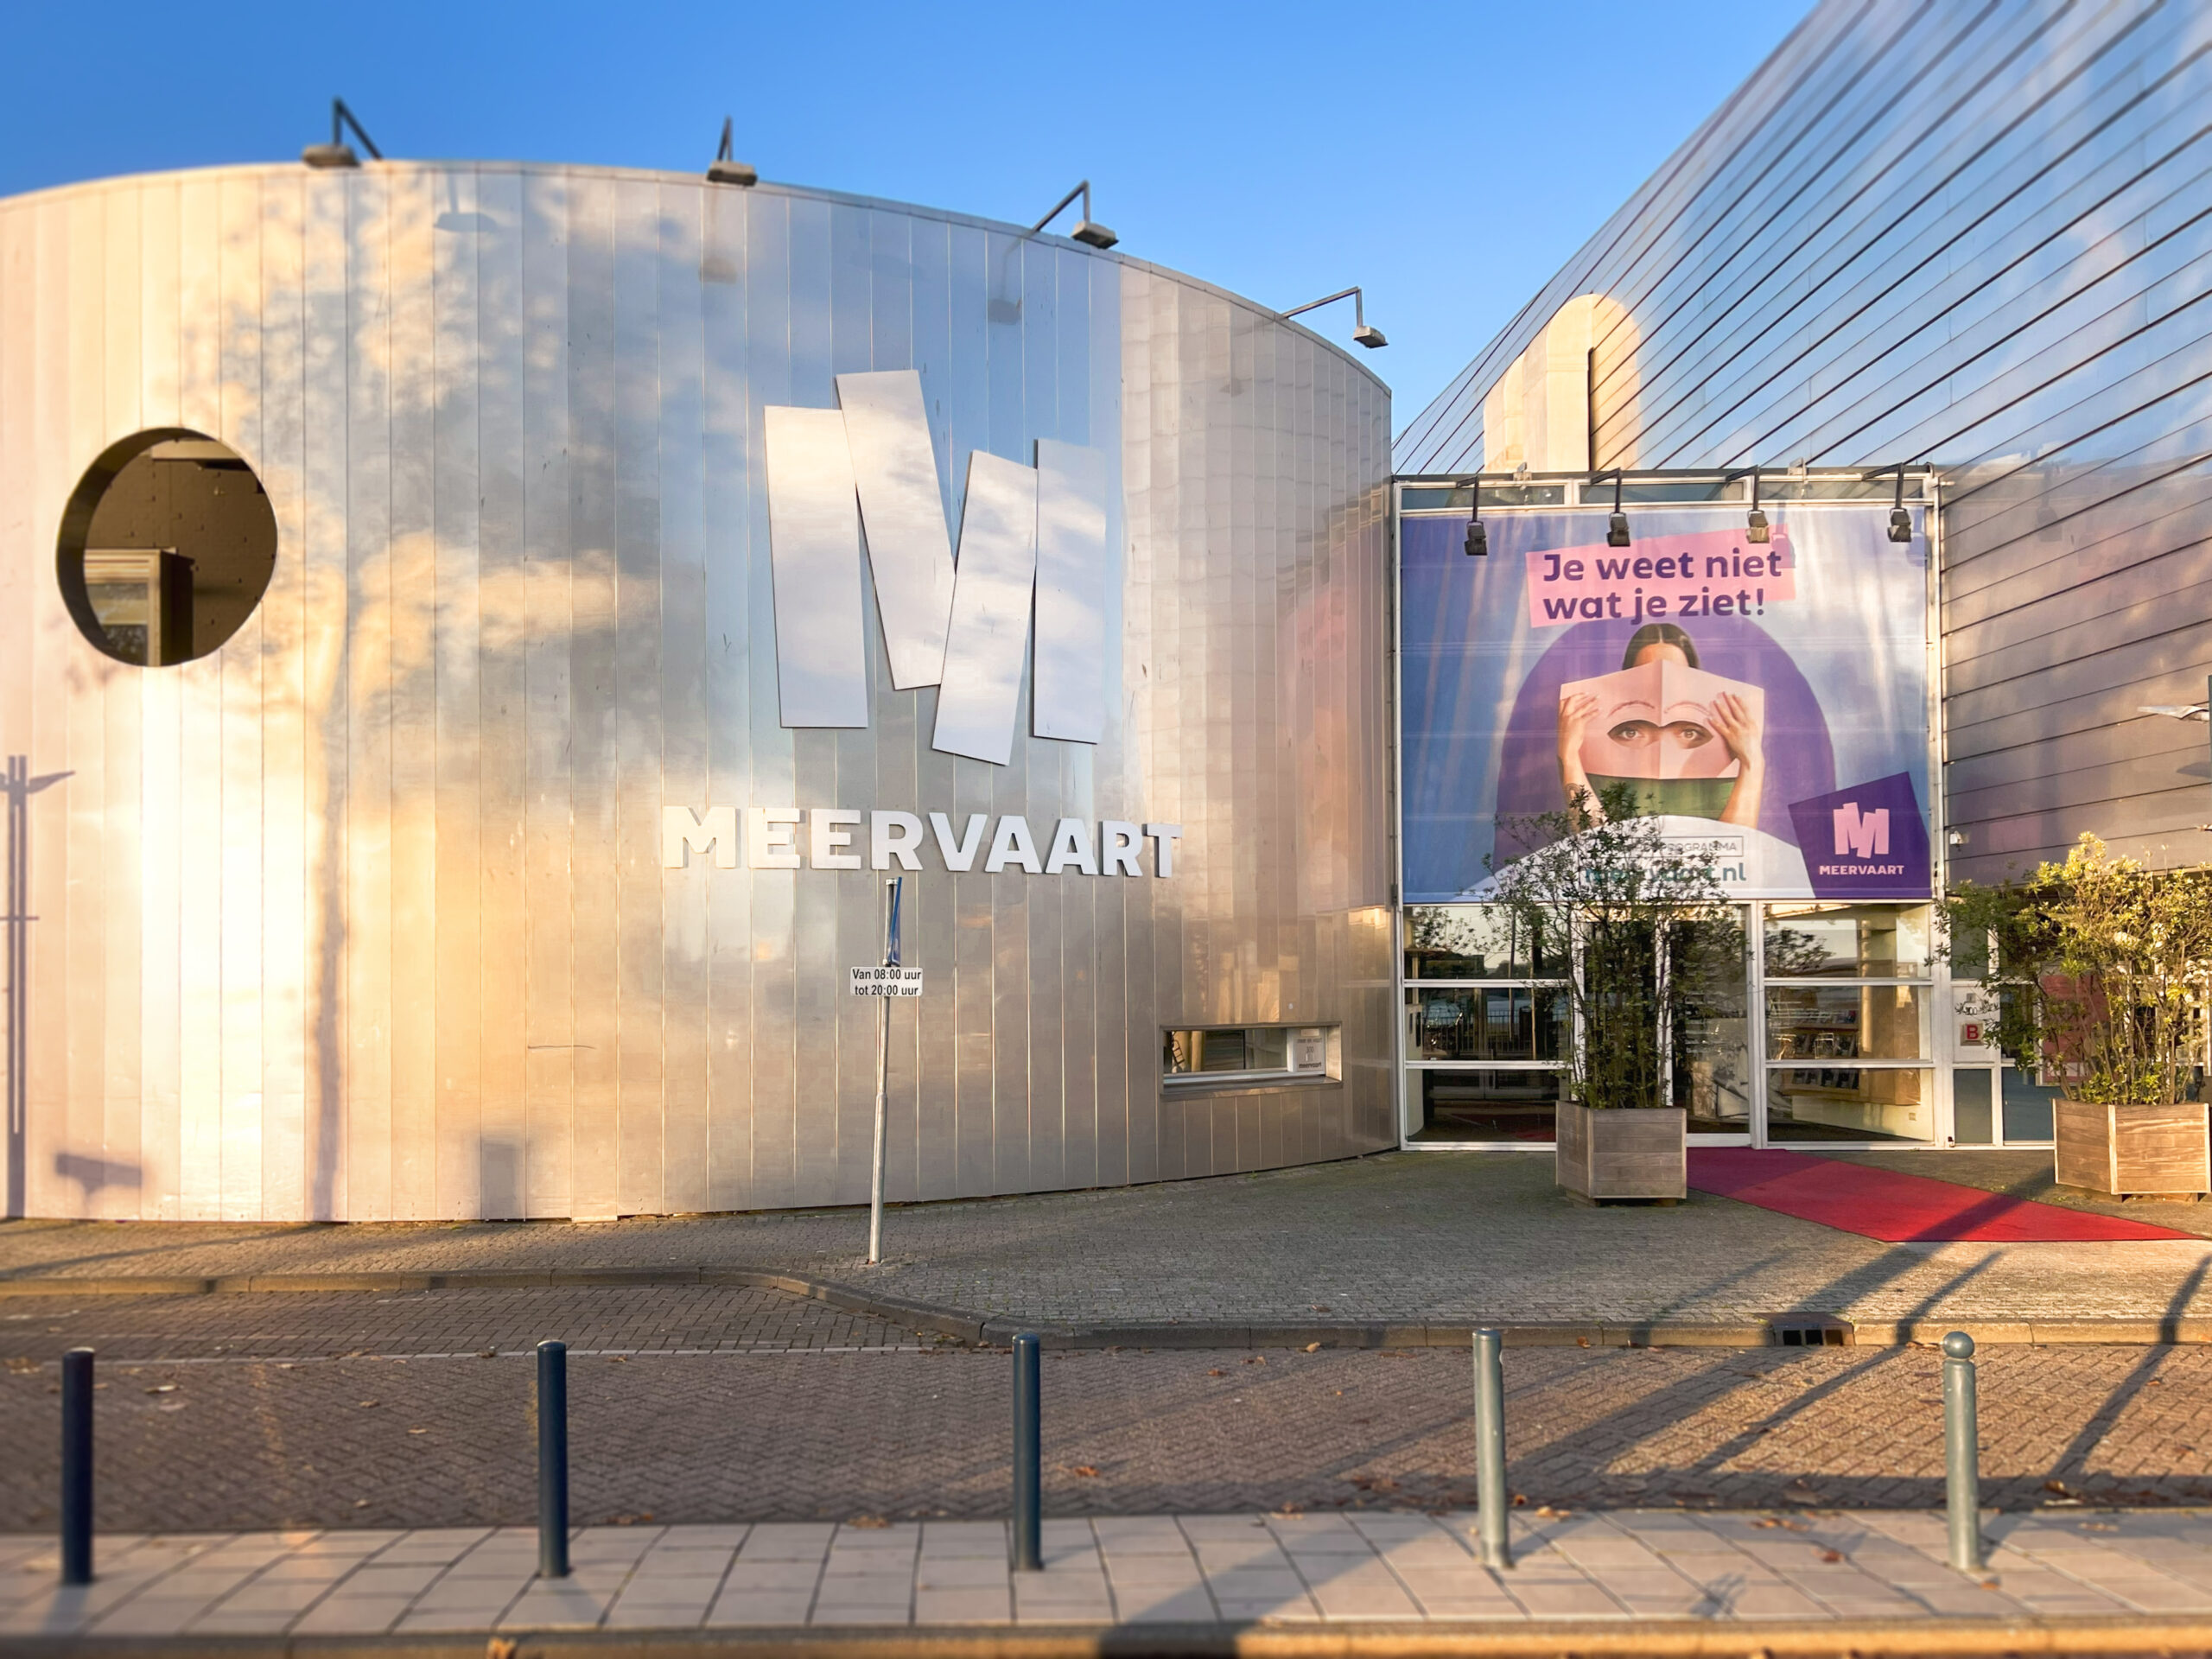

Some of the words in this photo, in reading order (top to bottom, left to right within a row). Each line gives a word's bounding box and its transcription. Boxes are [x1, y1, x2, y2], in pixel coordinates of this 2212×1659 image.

[1543, 553, 1585, 582] Je
[1596, 552, 1694, 580] weet
[1706, 547, 1782, 578] niet
[1542, 592, 1622, 620] wat
[1630, 588, 1667, 625] je
[1678, 586, 1764, 617] ziet!
[663, 805, 1183, 878] MEERVAART
[1660, 842, 1737, 852] ROGRAMMA
[1819, 865, 1904, 875] MEERVAART
[852, 969, 871, 980] Van
[874, 969, 901, 980] 08:00
[904, 969, 921, 980] uur
[855, 985, 868, 995] tot
[871, 984, 899, 995] 20:00
[901, 987, 918, 995] uur
[1967, 1024, 1979, 1039] B
